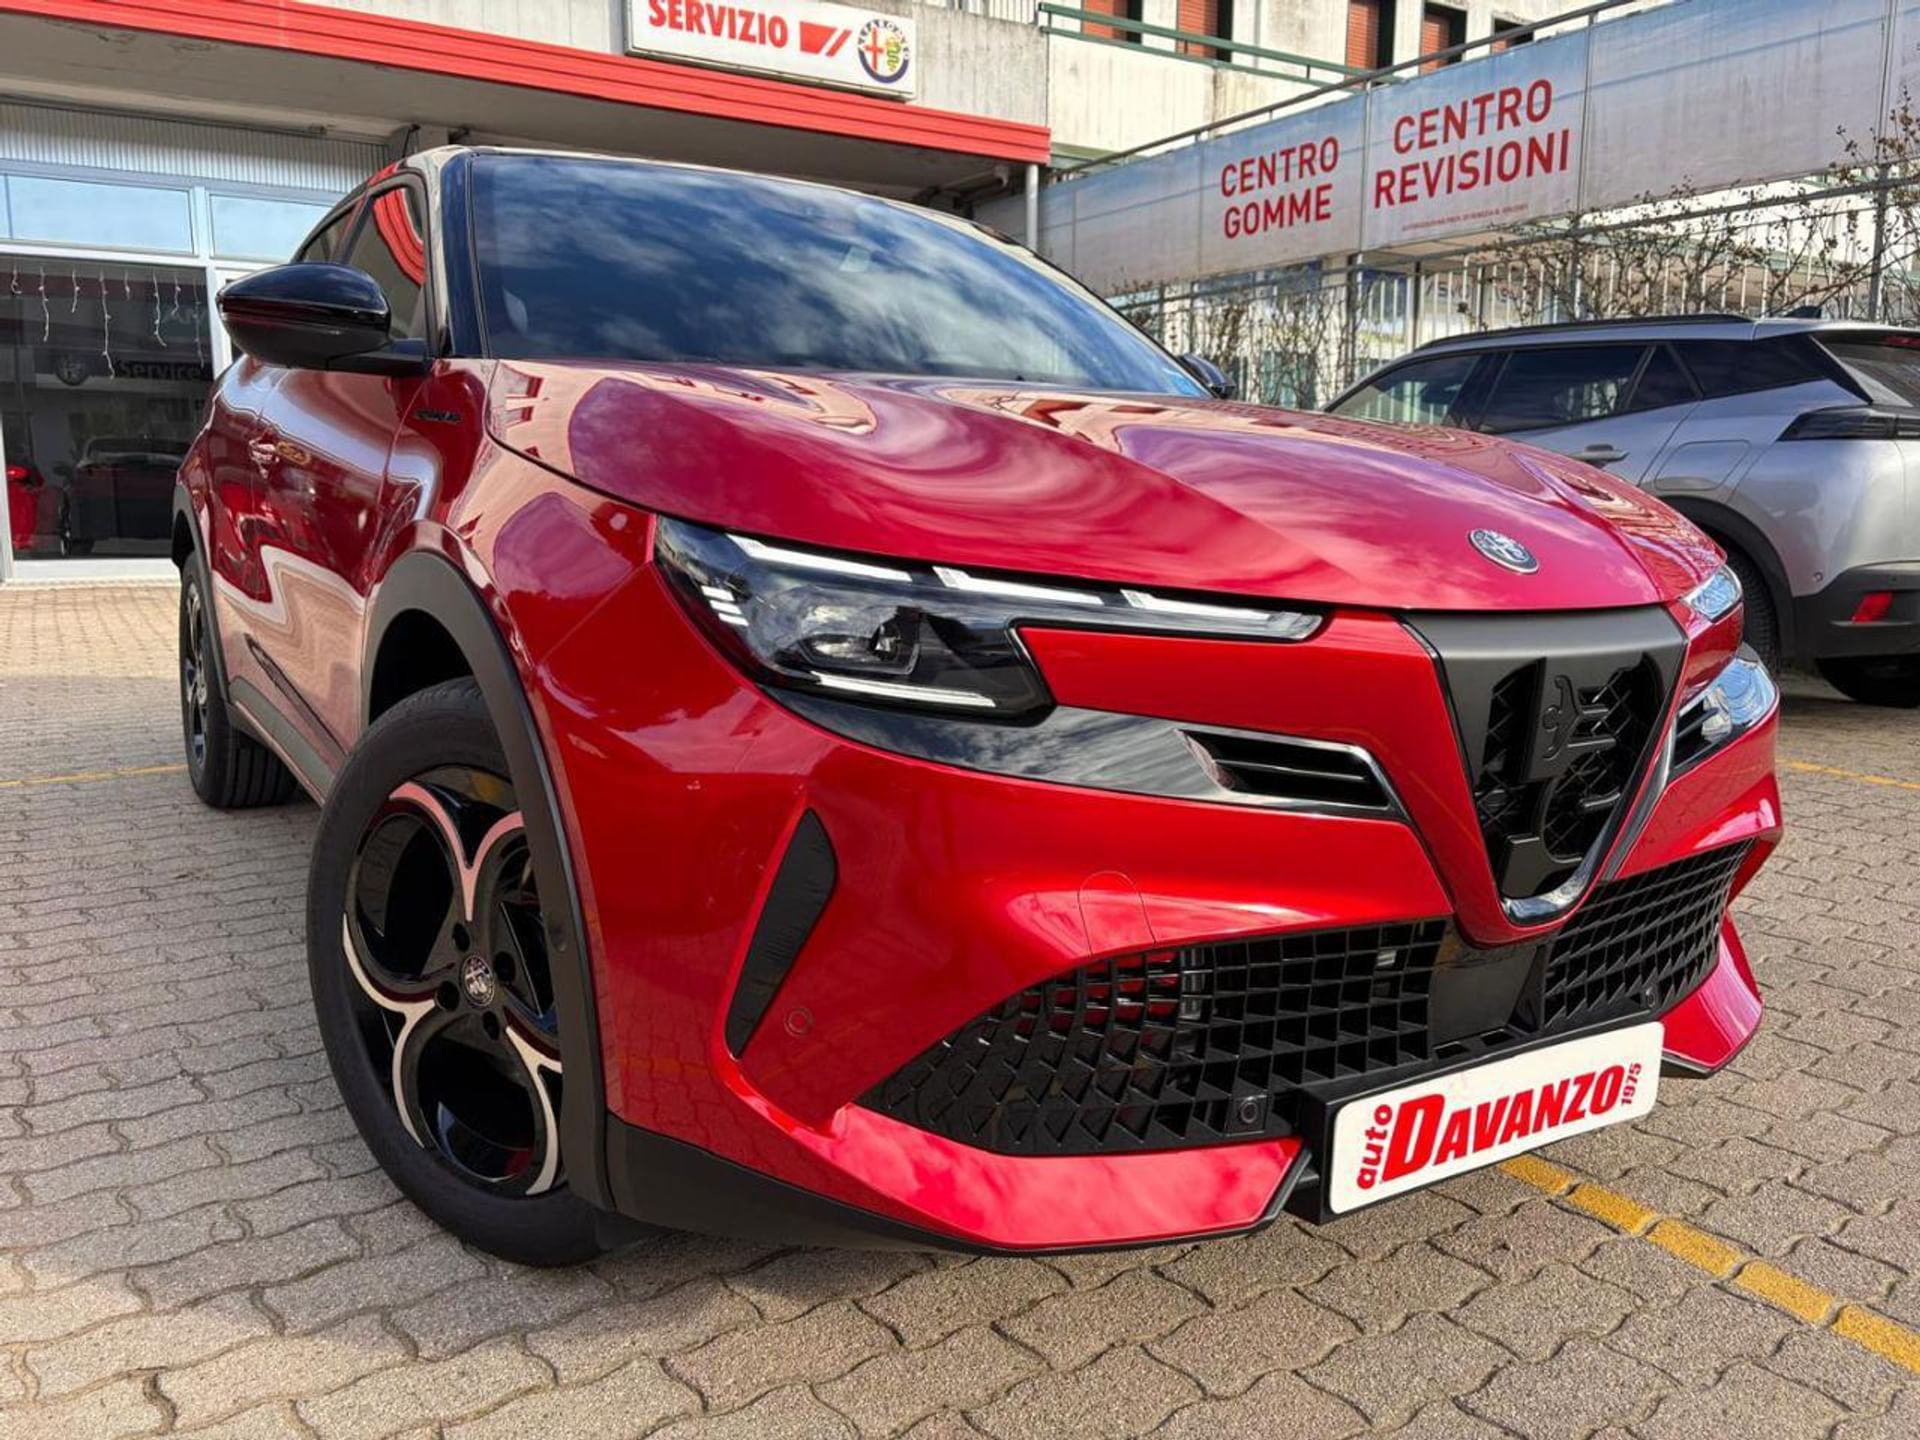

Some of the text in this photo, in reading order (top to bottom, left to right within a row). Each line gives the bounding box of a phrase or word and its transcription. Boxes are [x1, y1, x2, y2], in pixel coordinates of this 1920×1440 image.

[649, 0, 788, 48] SERVIZIO
[1393, 79, 1553, 155] CENTRO
[1220, 136, 1339, 197] CENTRO
[1374, 129, 1570, 208] REVISIONI
[1224, 183, 1333, 239] GOMME
[118, 360, 201, 381] Service
[1621, 1062, 1642, 1105] 1975
[1357, 1104, 1393, 1190] auto
[1381, 1064, 1625, 1183] DAVANZO
